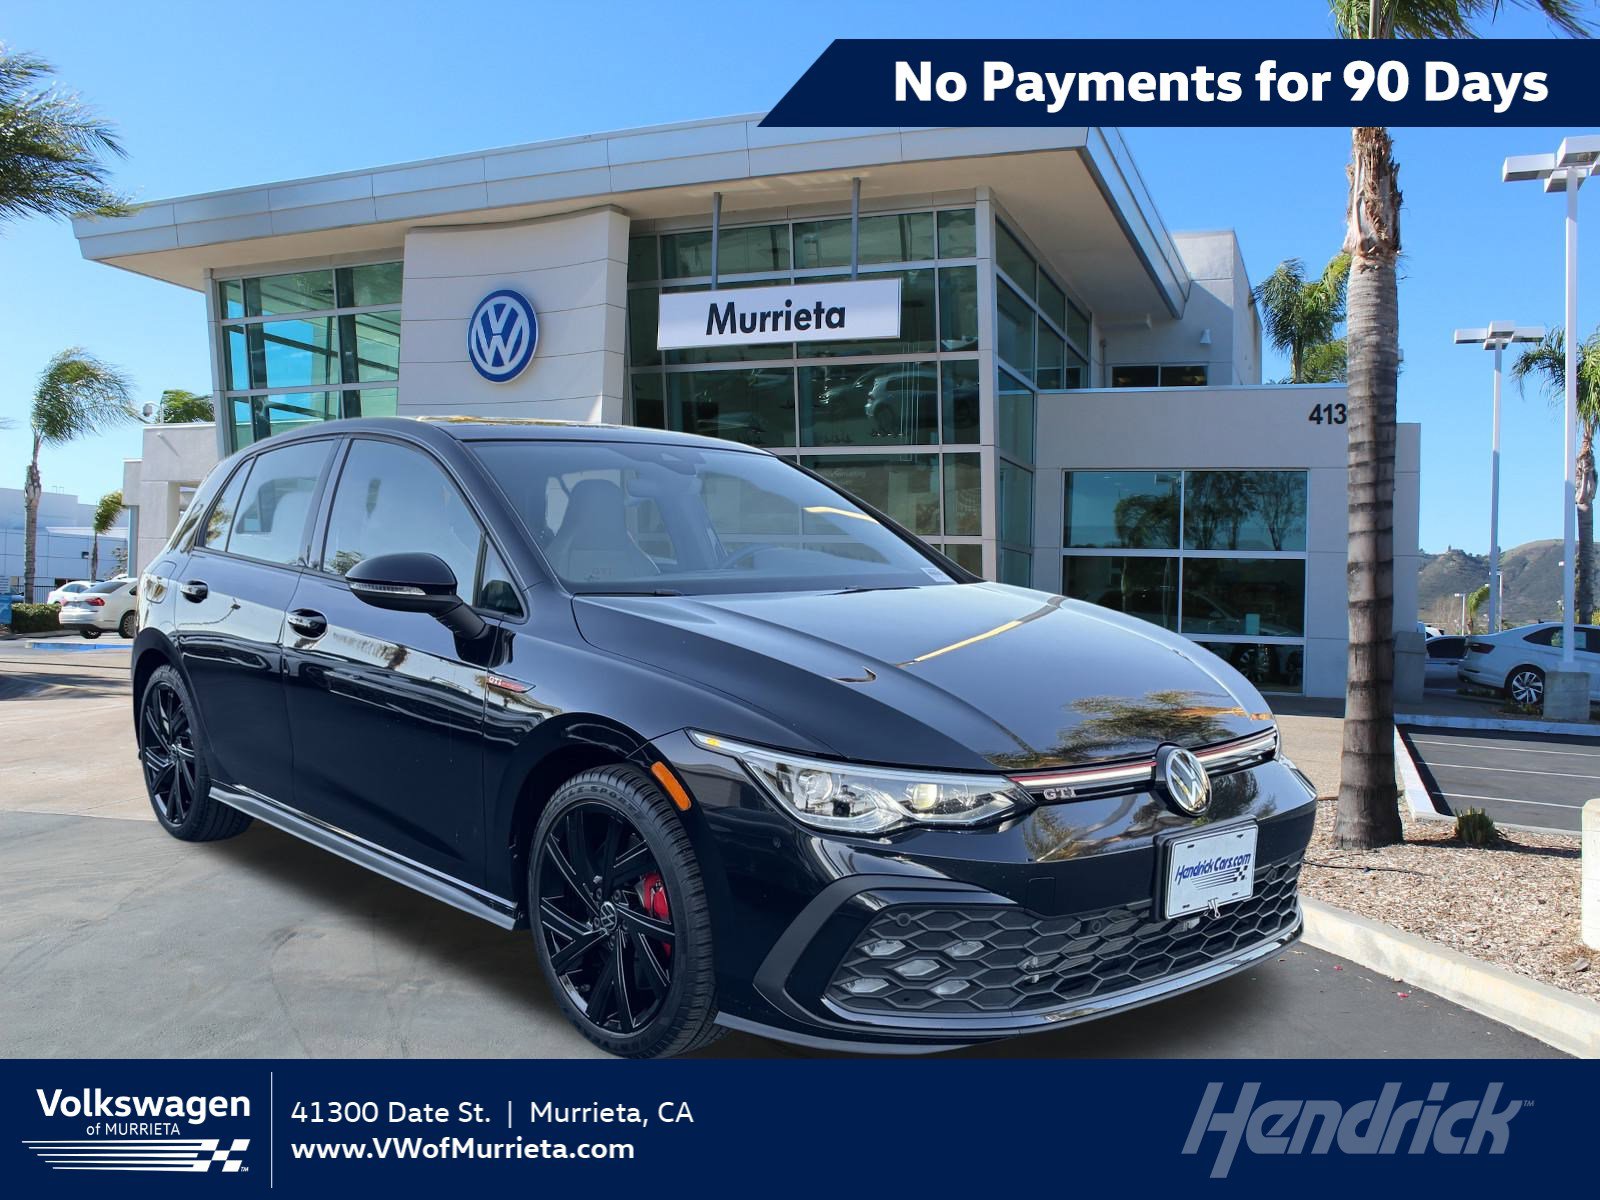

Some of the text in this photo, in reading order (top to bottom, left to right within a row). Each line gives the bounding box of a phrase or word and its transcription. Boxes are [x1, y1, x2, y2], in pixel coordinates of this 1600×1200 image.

[706, 299, 846, 336] Murrieta
[1308, 403, 1347, 425] 413
[1043, 786, 1077, 801] GTI
